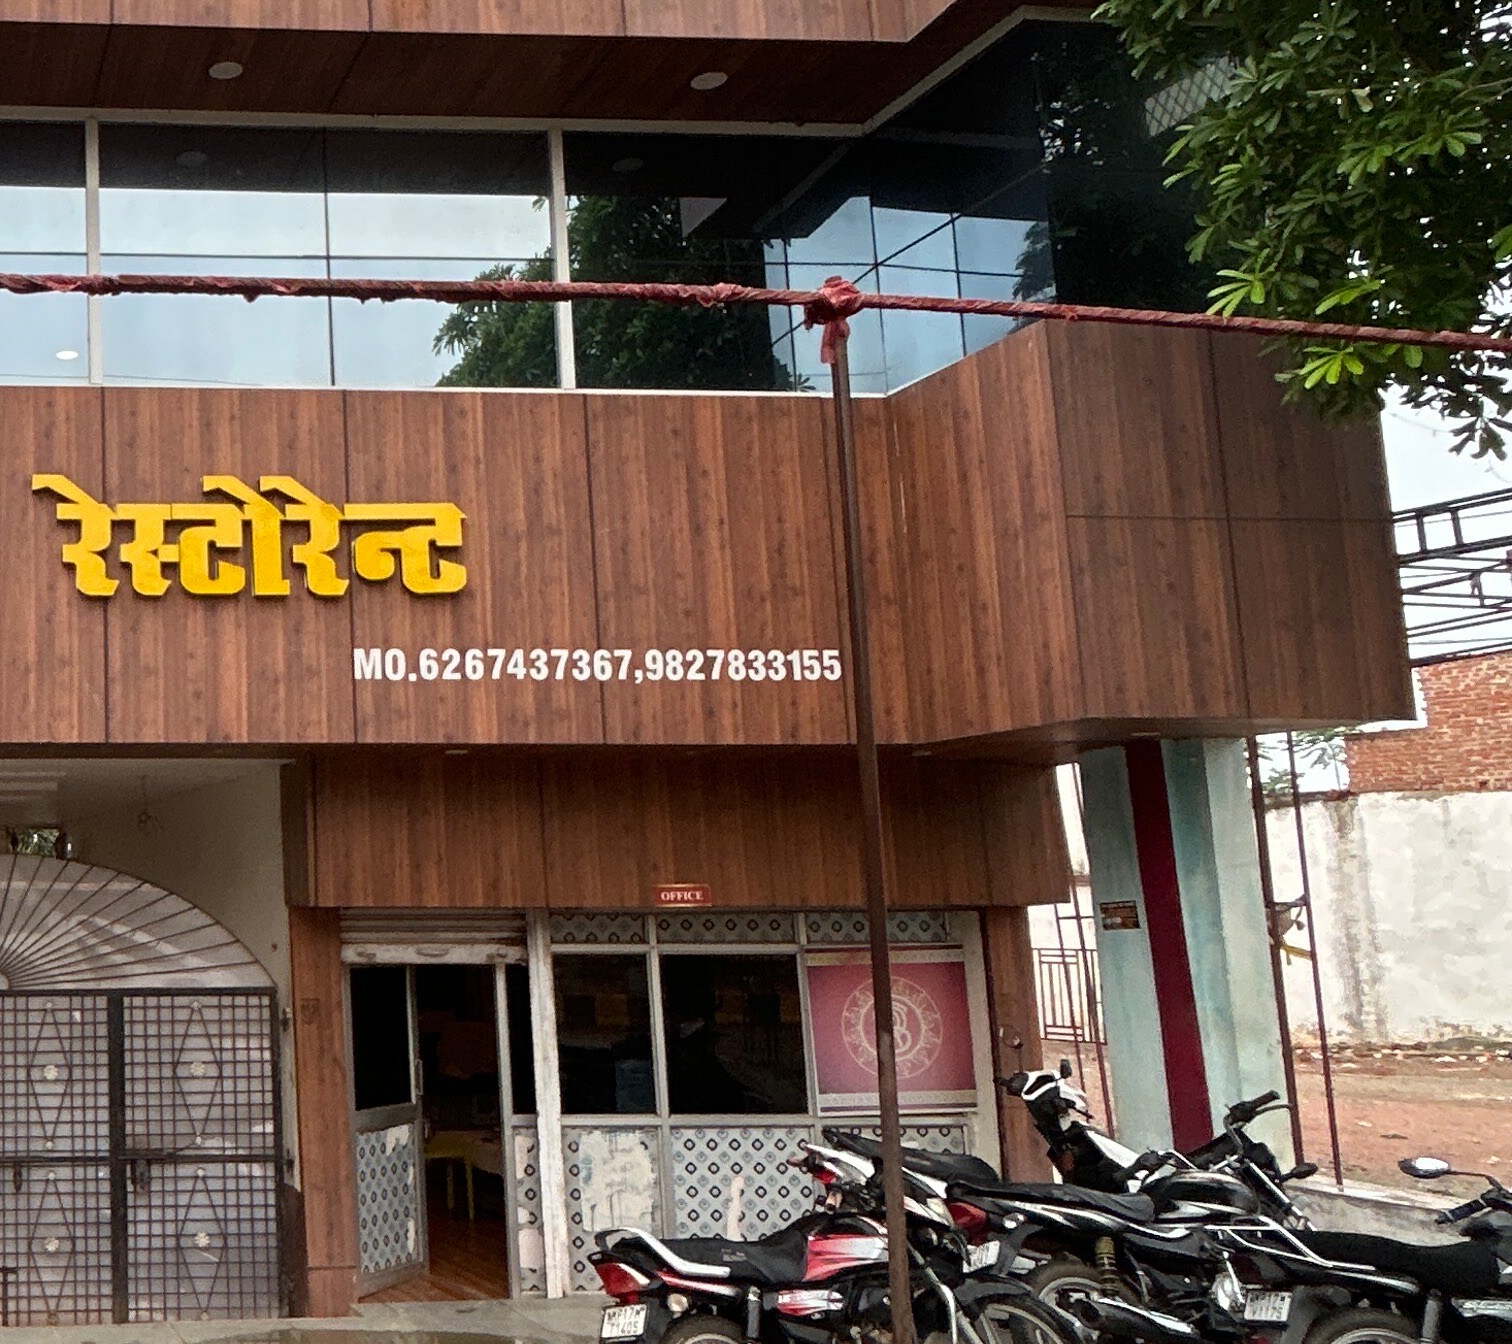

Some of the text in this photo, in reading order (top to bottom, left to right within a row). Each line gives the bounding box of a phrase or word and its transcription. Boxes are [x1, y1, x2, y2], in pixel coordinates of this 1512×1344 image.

[31, 473, 469, 598] रेस्टोरेन्ट
[354, 647, 842, 685] MO.6267437367,9827833155
[660, 891, 704, 902] OFFICE
